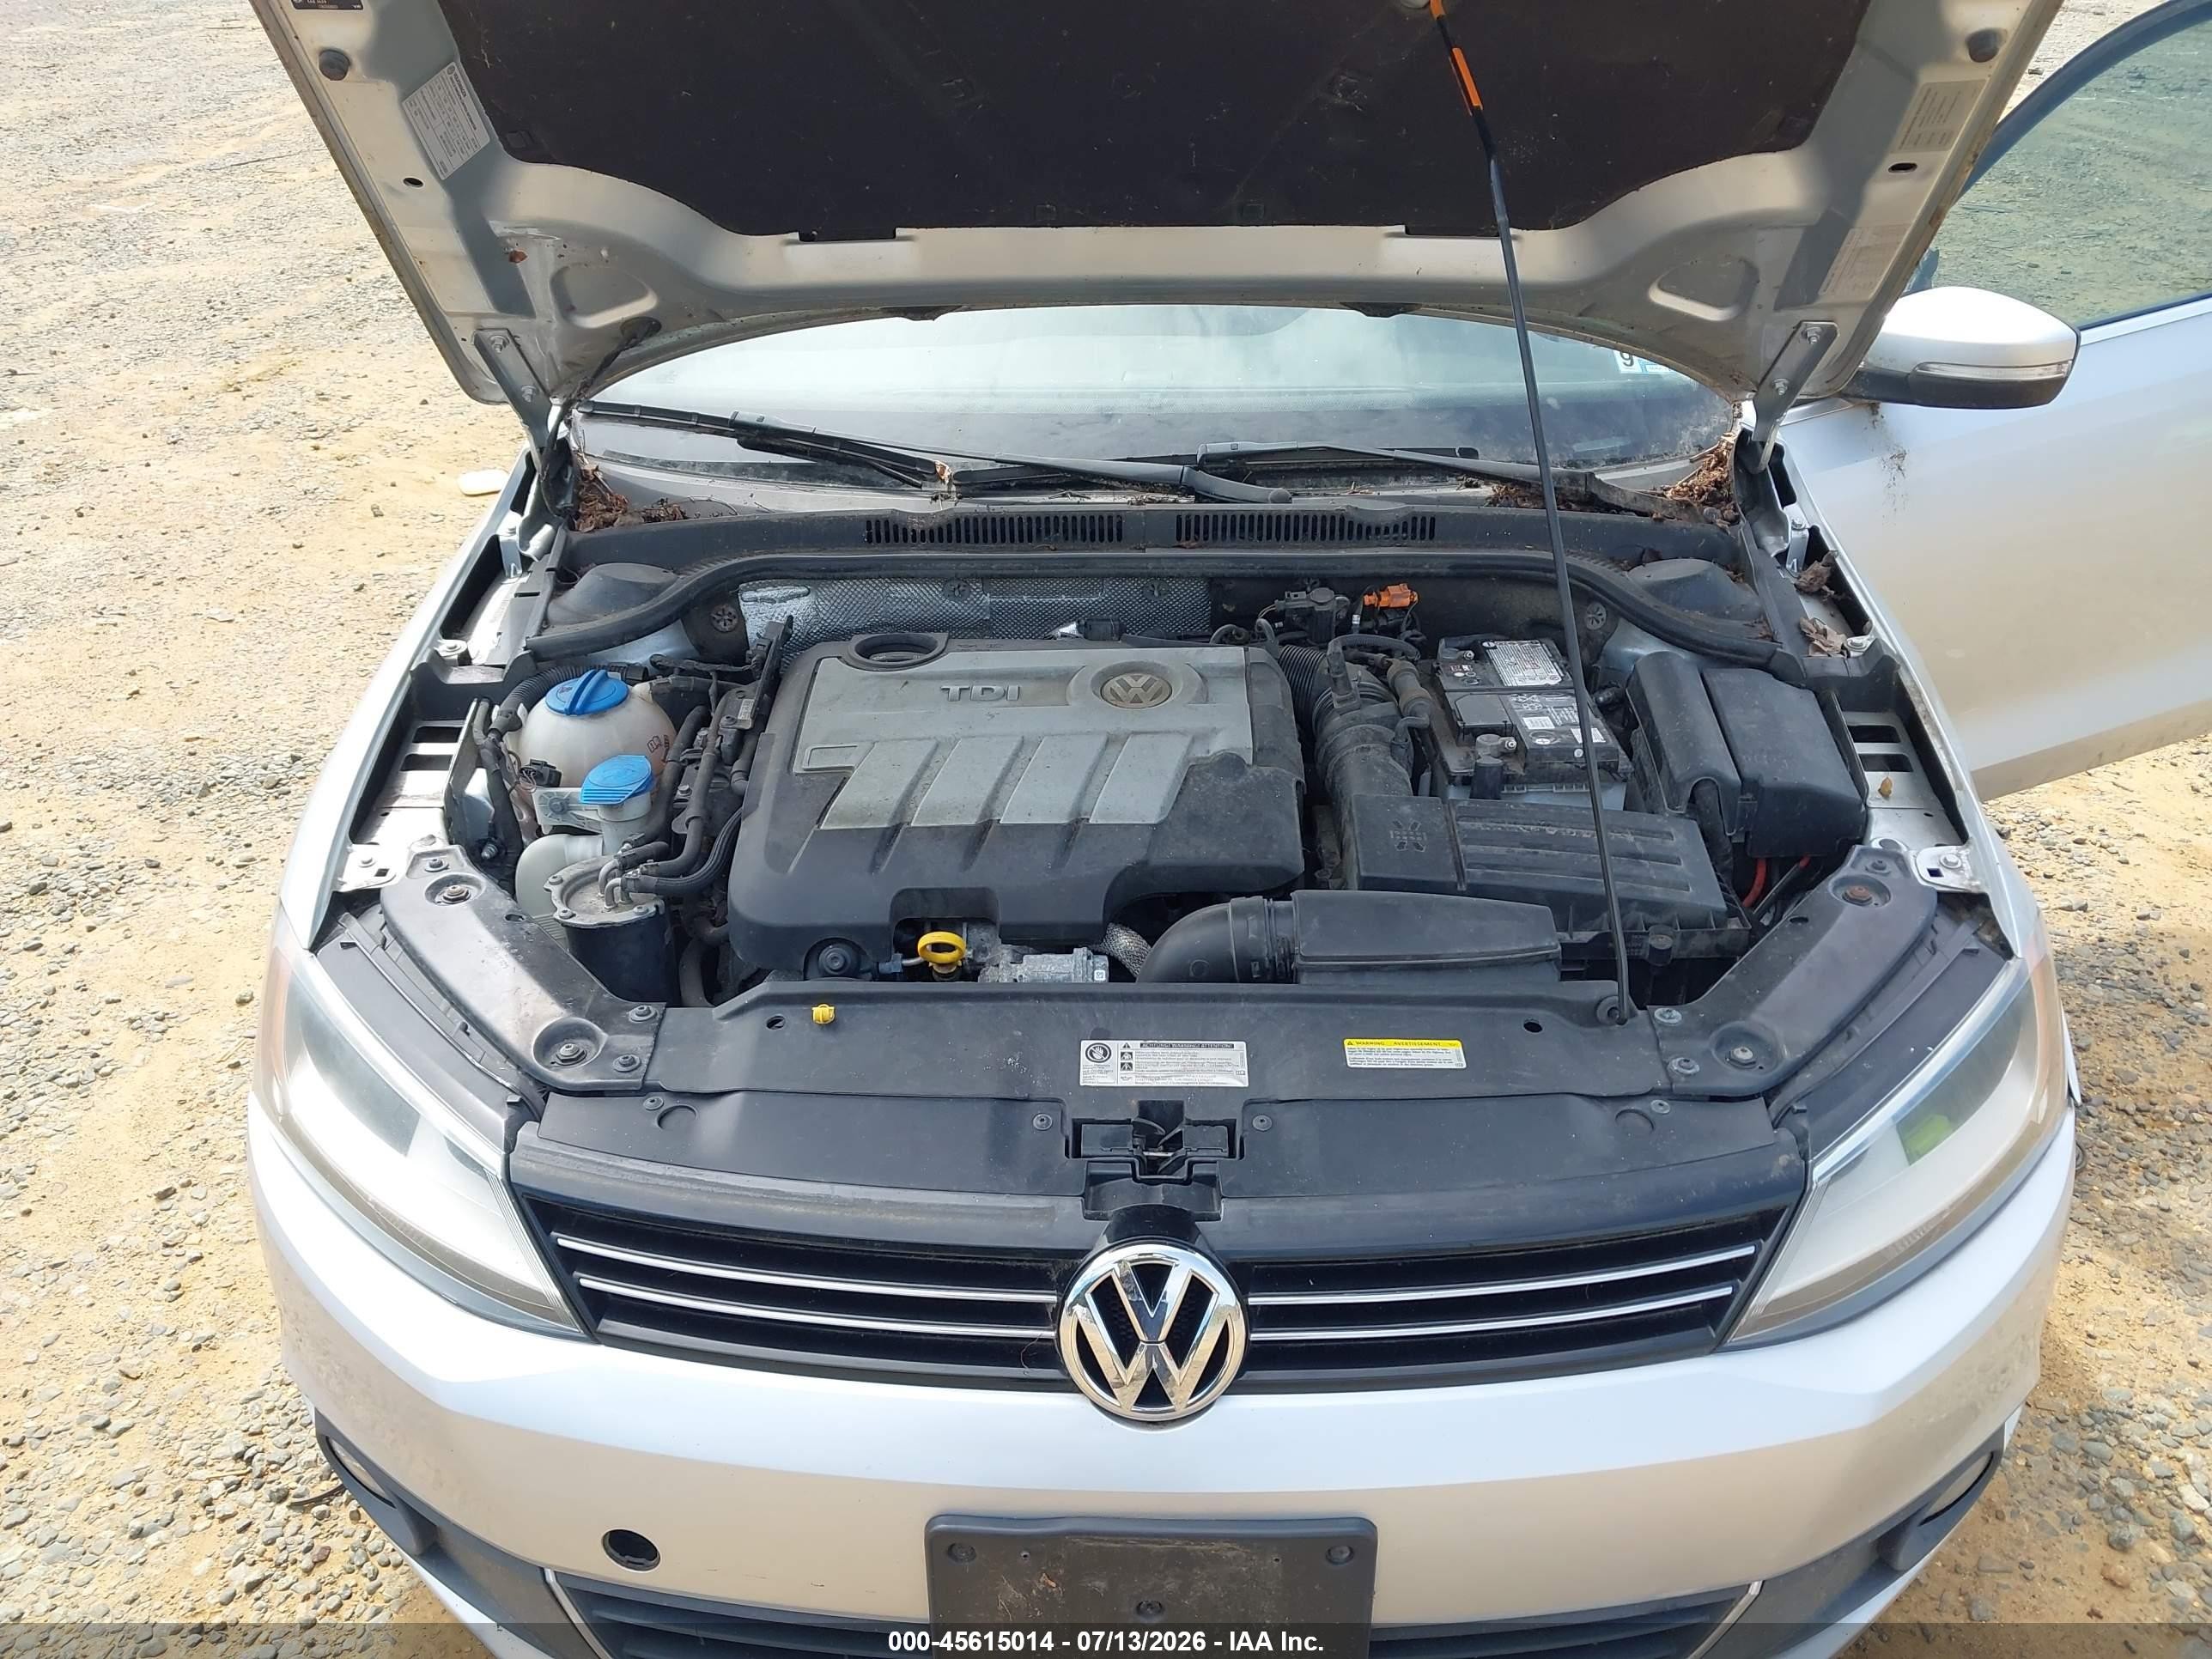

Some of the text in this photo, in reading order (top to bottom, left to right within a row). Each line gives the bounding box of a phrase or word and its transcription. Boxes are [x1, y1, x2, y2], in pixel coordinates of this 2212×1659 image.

[940, 684, 1020, 702] TDI
[1100, 672, 1173, 709] VW
[1060, 1243, 1246, 1422] VW
